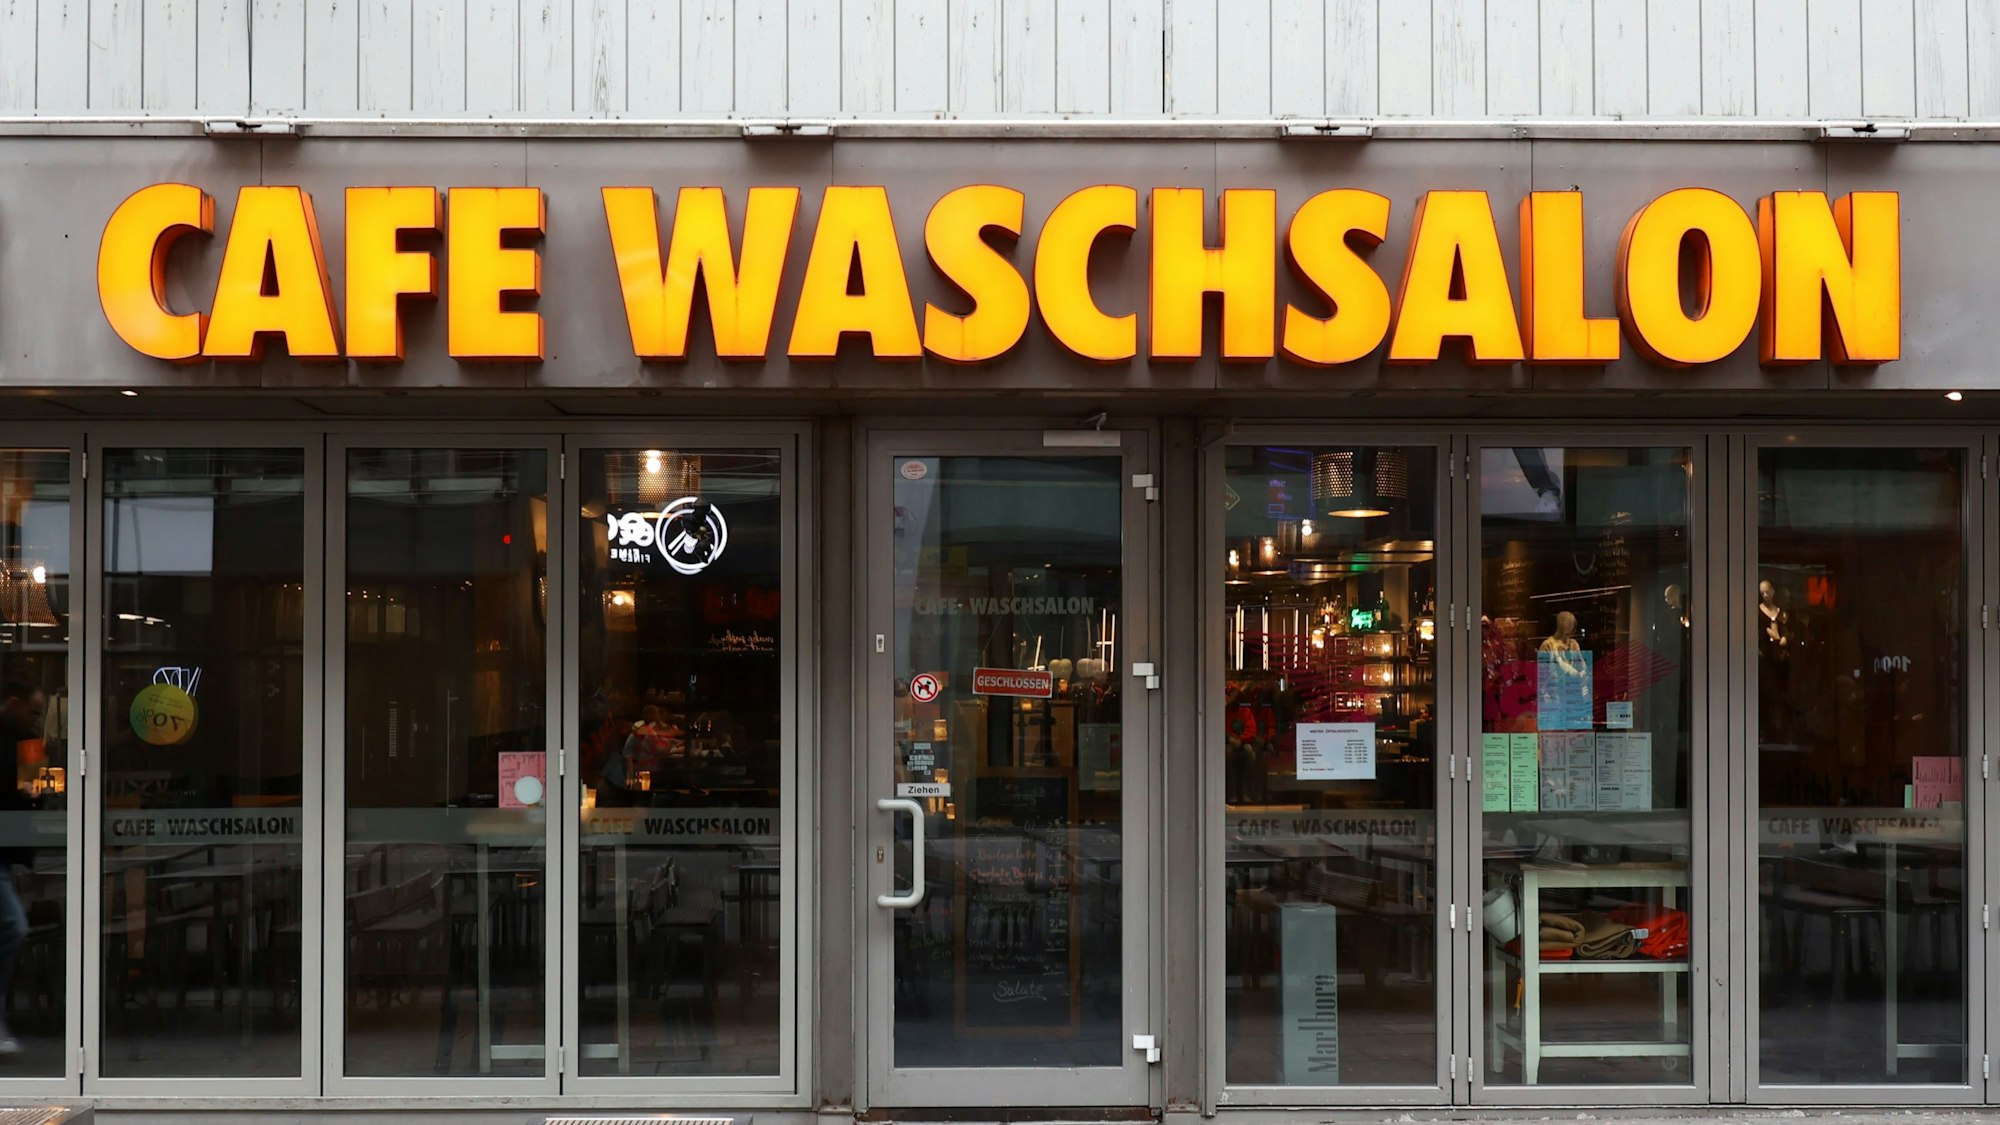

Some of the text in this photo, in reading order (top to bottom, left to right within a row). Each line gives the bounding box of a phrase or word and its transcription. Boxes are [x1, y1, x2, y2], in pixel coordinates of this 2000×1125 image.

[97, 182, 1902, 367] CAFE WASCHSALON
[915, 597, 1095, 615] CAFE WASCHSALON
[976, 674, 1050, 690] GESCHLOSSEN
[907, 786, 940, 794] Ziehen
[113, 817, 294, 836] CAFE WASCHSALON
[590, 818, 771, 835] CAFE WASCHSALON
[1238, 818, 1416, 836] CAFE WASCHSALON
[1768, 818, 1810, 834] CAFE
[998, 979, 1044, 998] Salute
[1297, 974, 1337, 1073] Marlboro
